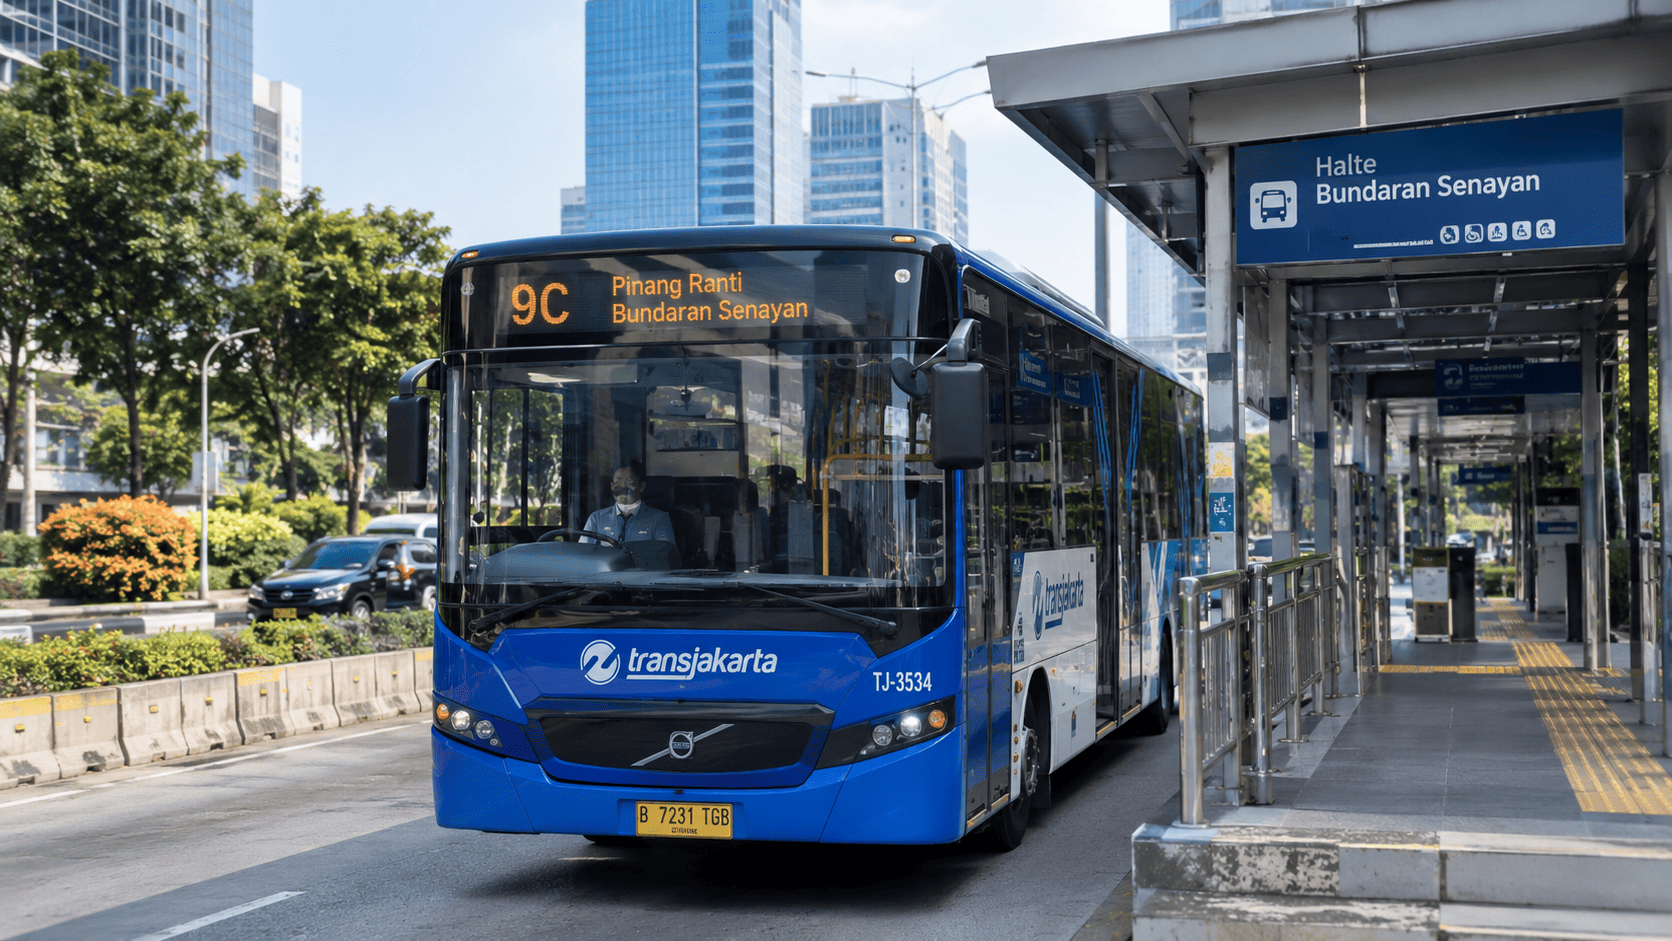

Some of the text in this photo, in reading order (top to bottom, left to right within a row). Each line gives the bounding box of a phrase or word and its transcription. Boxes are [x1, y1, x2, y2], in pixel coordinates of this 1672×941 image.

[1315, 154, 1377, 178] Halte
[1315, 173, 1541, 205] Bundaran Senayan
[612, 271, 743, 299] Pinang Ranti
[511, 282, 570, 326] 9C
[612, 299, 809, 324] Bundaran Senayan
[626, 647, 778, 680] transjakarta
[873, 671, 933, 692] TJ-3534
[639, 805, 730, 827] B 7231 TGB
